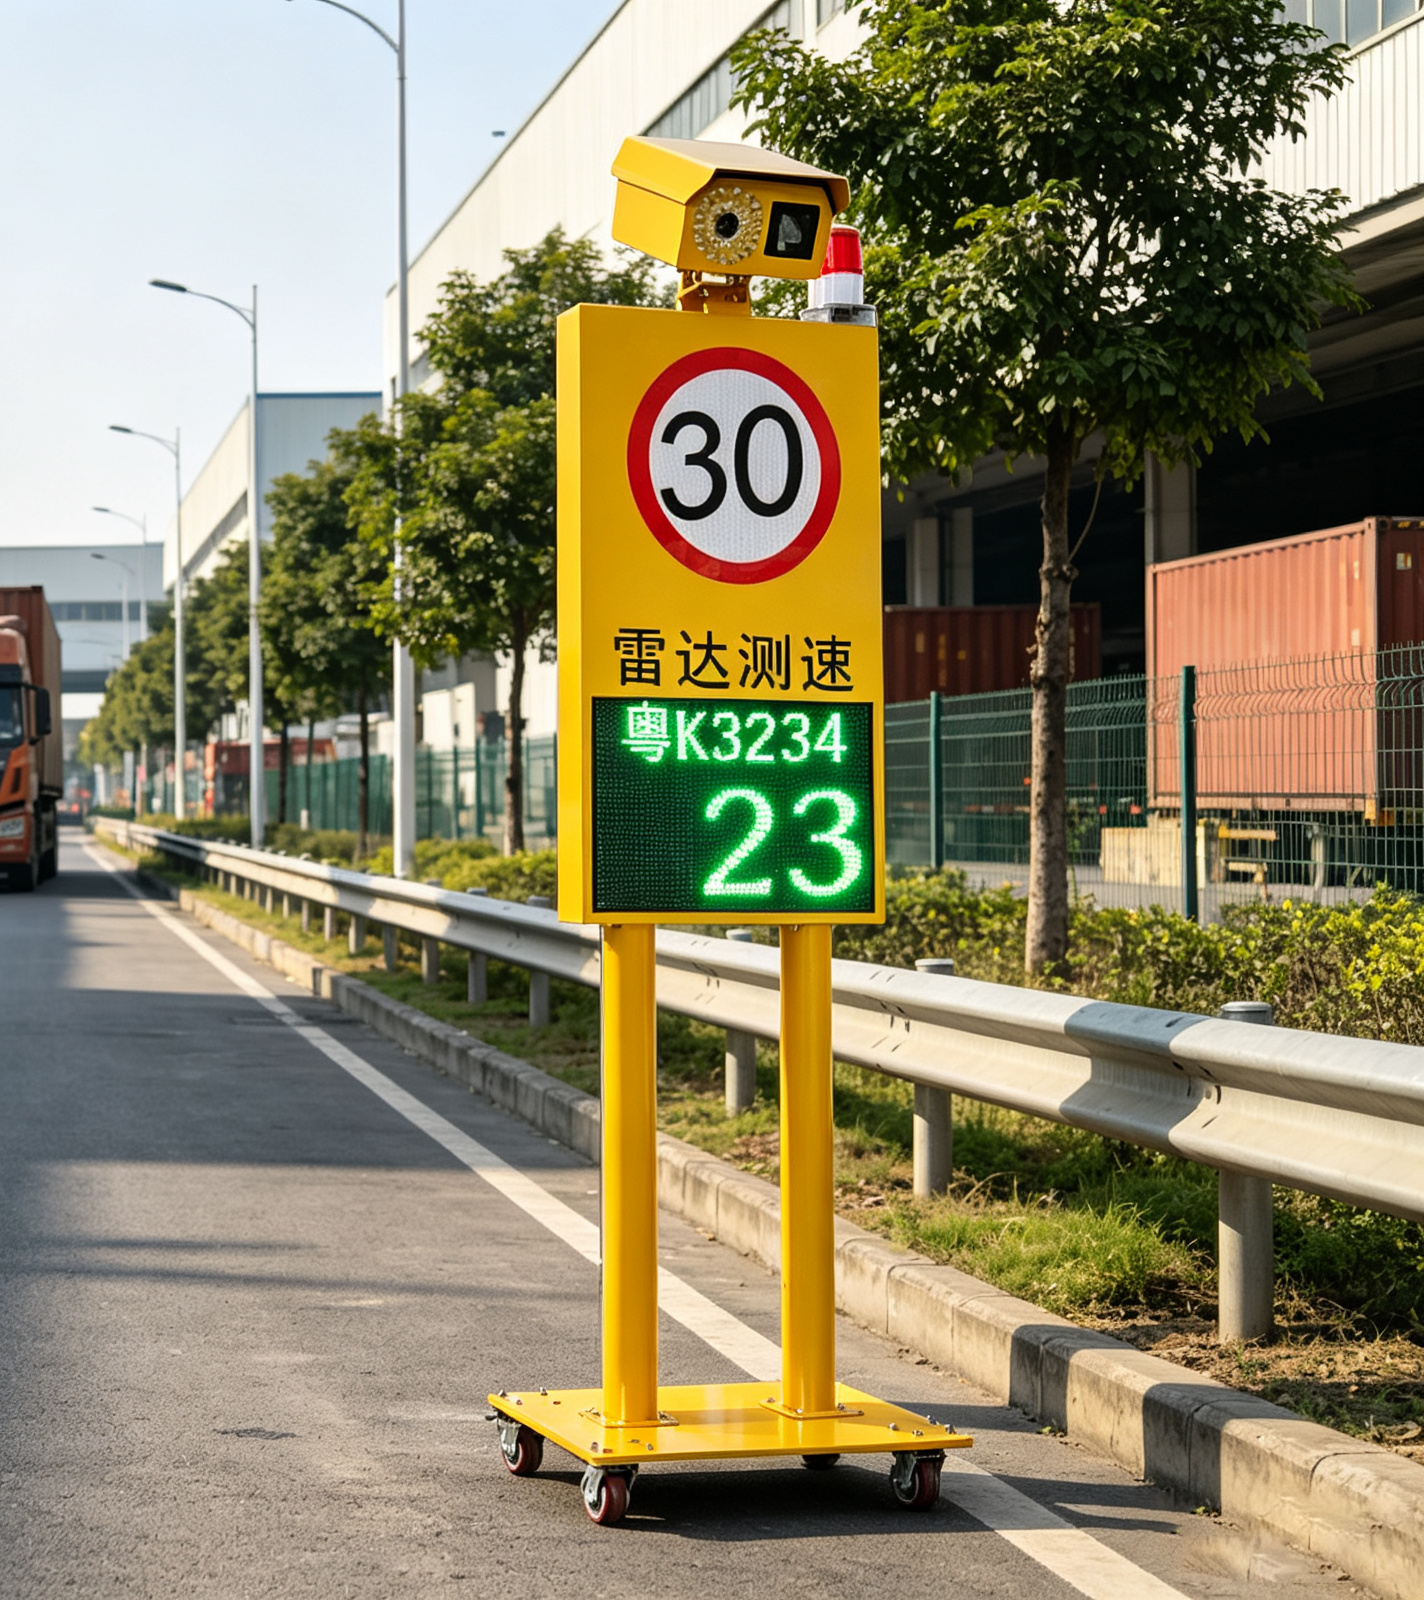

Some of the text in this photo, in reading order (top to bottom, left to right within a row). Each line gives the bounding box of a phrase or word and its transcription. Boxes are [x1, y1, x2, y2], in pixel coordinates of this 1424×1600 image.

[660, 404, 803, 521] 30
[614, 628, 854, 692] 雷达测速
[620, 701, 847, 764] 粤K3234
[702, 787, 862, 897] 23
